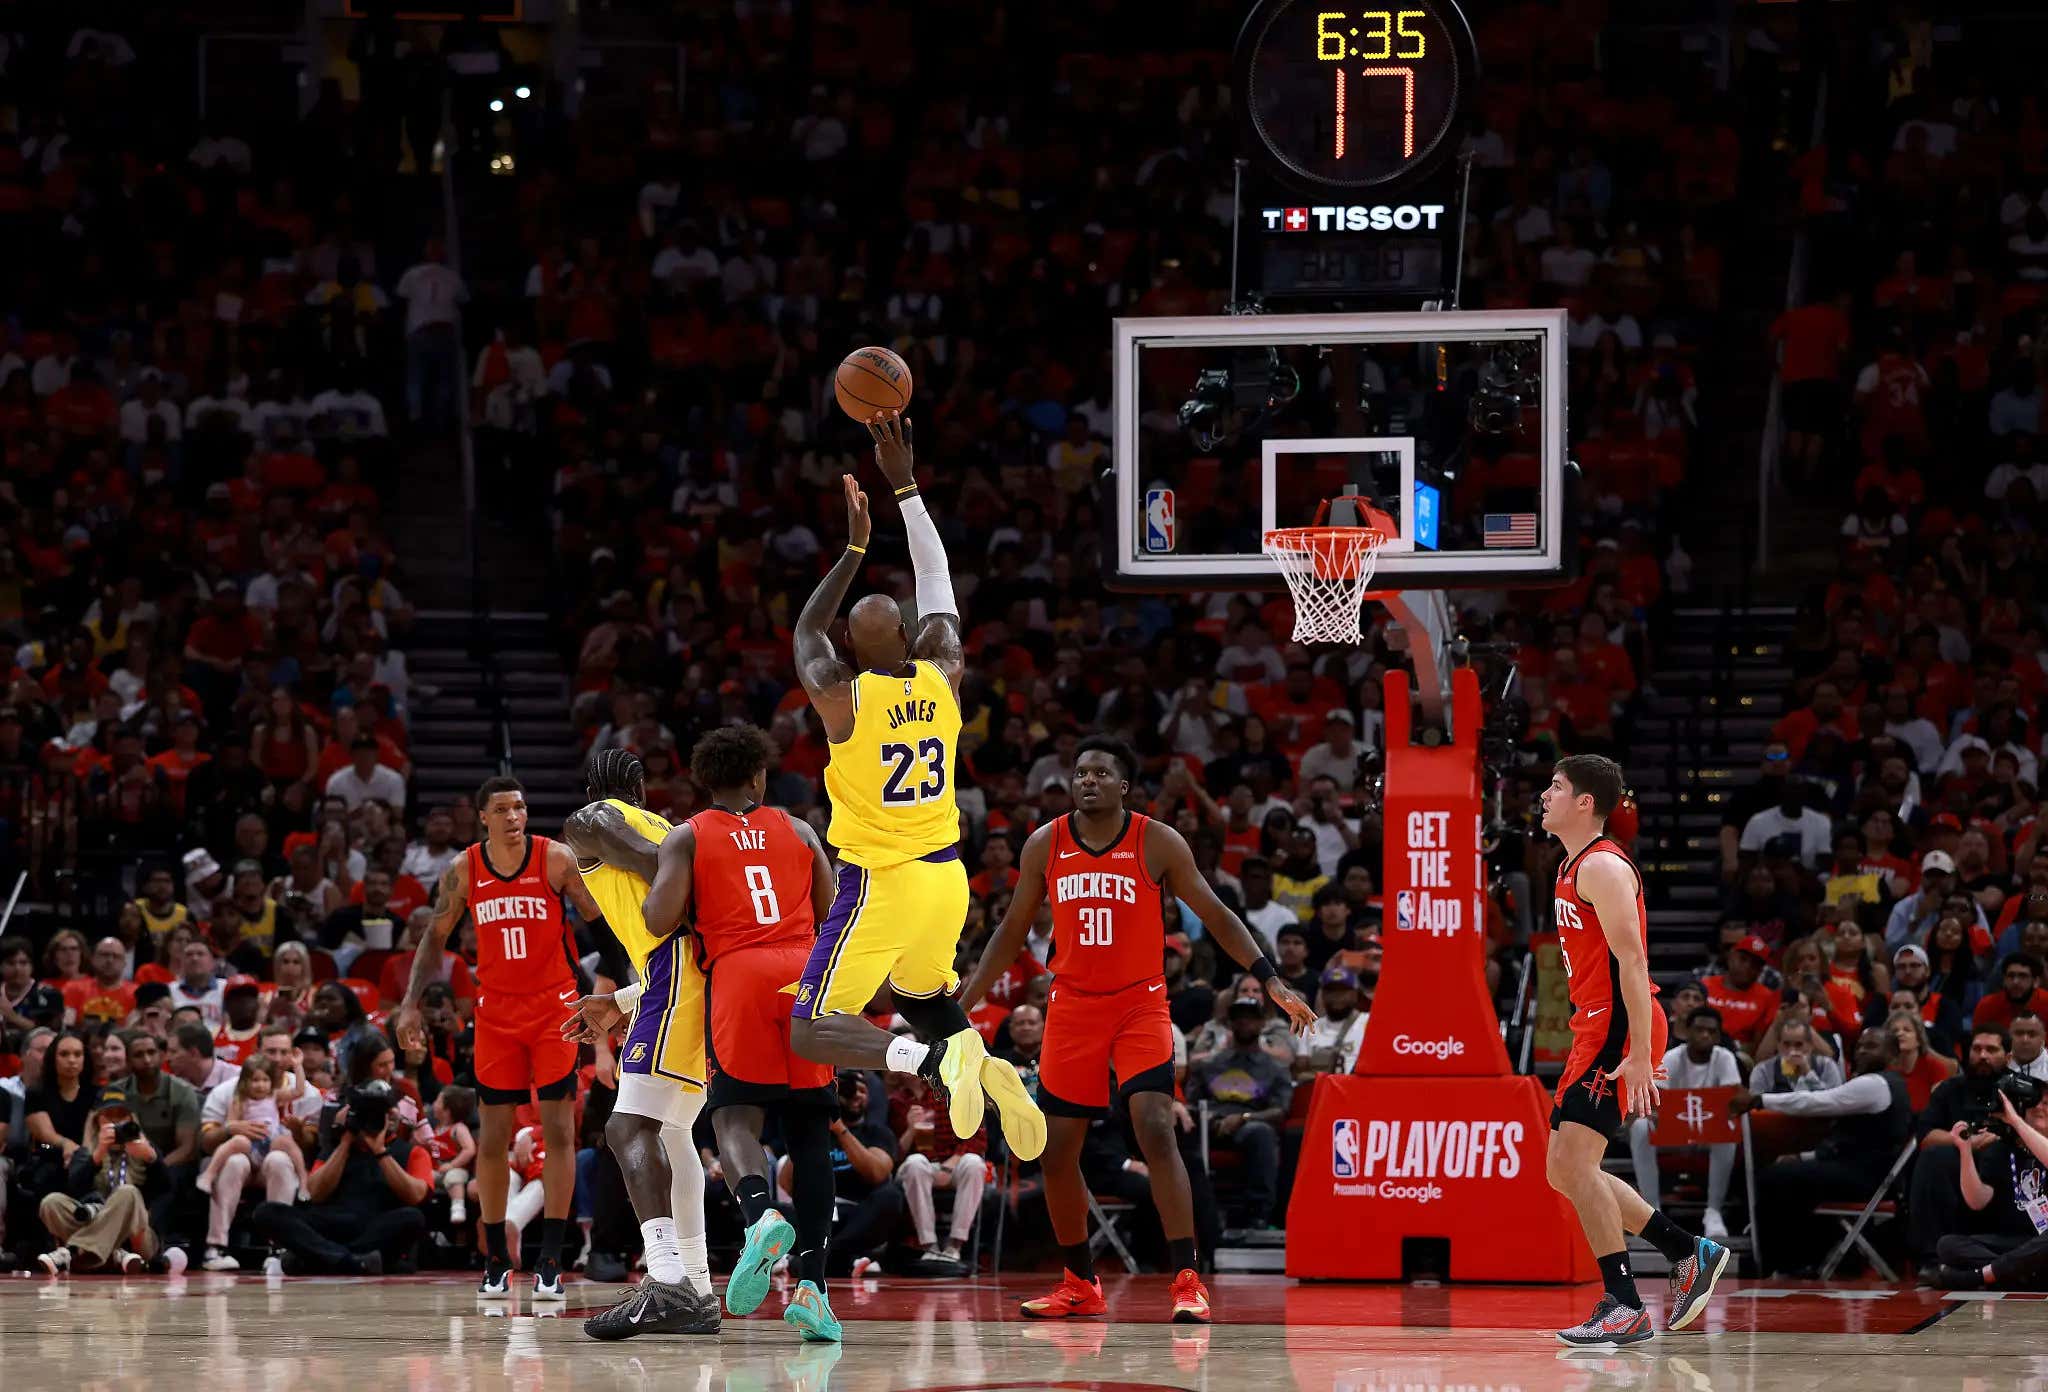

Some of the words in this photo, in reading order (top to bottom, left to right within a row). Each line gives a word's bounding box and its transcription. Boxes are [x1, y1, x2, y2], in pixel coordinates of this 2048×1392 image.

[1317, 11, 1425, 60] 6:35
[1335, 67, 1414, 159] 17
[1312, 205, 1444, 231] TISSOT
[887, 700, 936, 729] JAMES
[880, 736, 946, 807] 23
[729, 829, 766, 850] TATE
[1407, 811, 1450, 848] GET
[1407, 851, 1451, 887] THE
[745, 865, 781, 924] 8
[1056, 873, 1136, 904] ROCKETS
[476, 896, 547, 925] ROCKETS
[1079, 907, 1113, 946] 30
[1417, 891, 1461, 937] App
[501, 927, 527, 960] 10
[1393, 1034, 1464, 1060] Google
[1363, 1120, 1524, 1179] PLAYOFFS
[1379, 1181, 1442, 1203] Google
